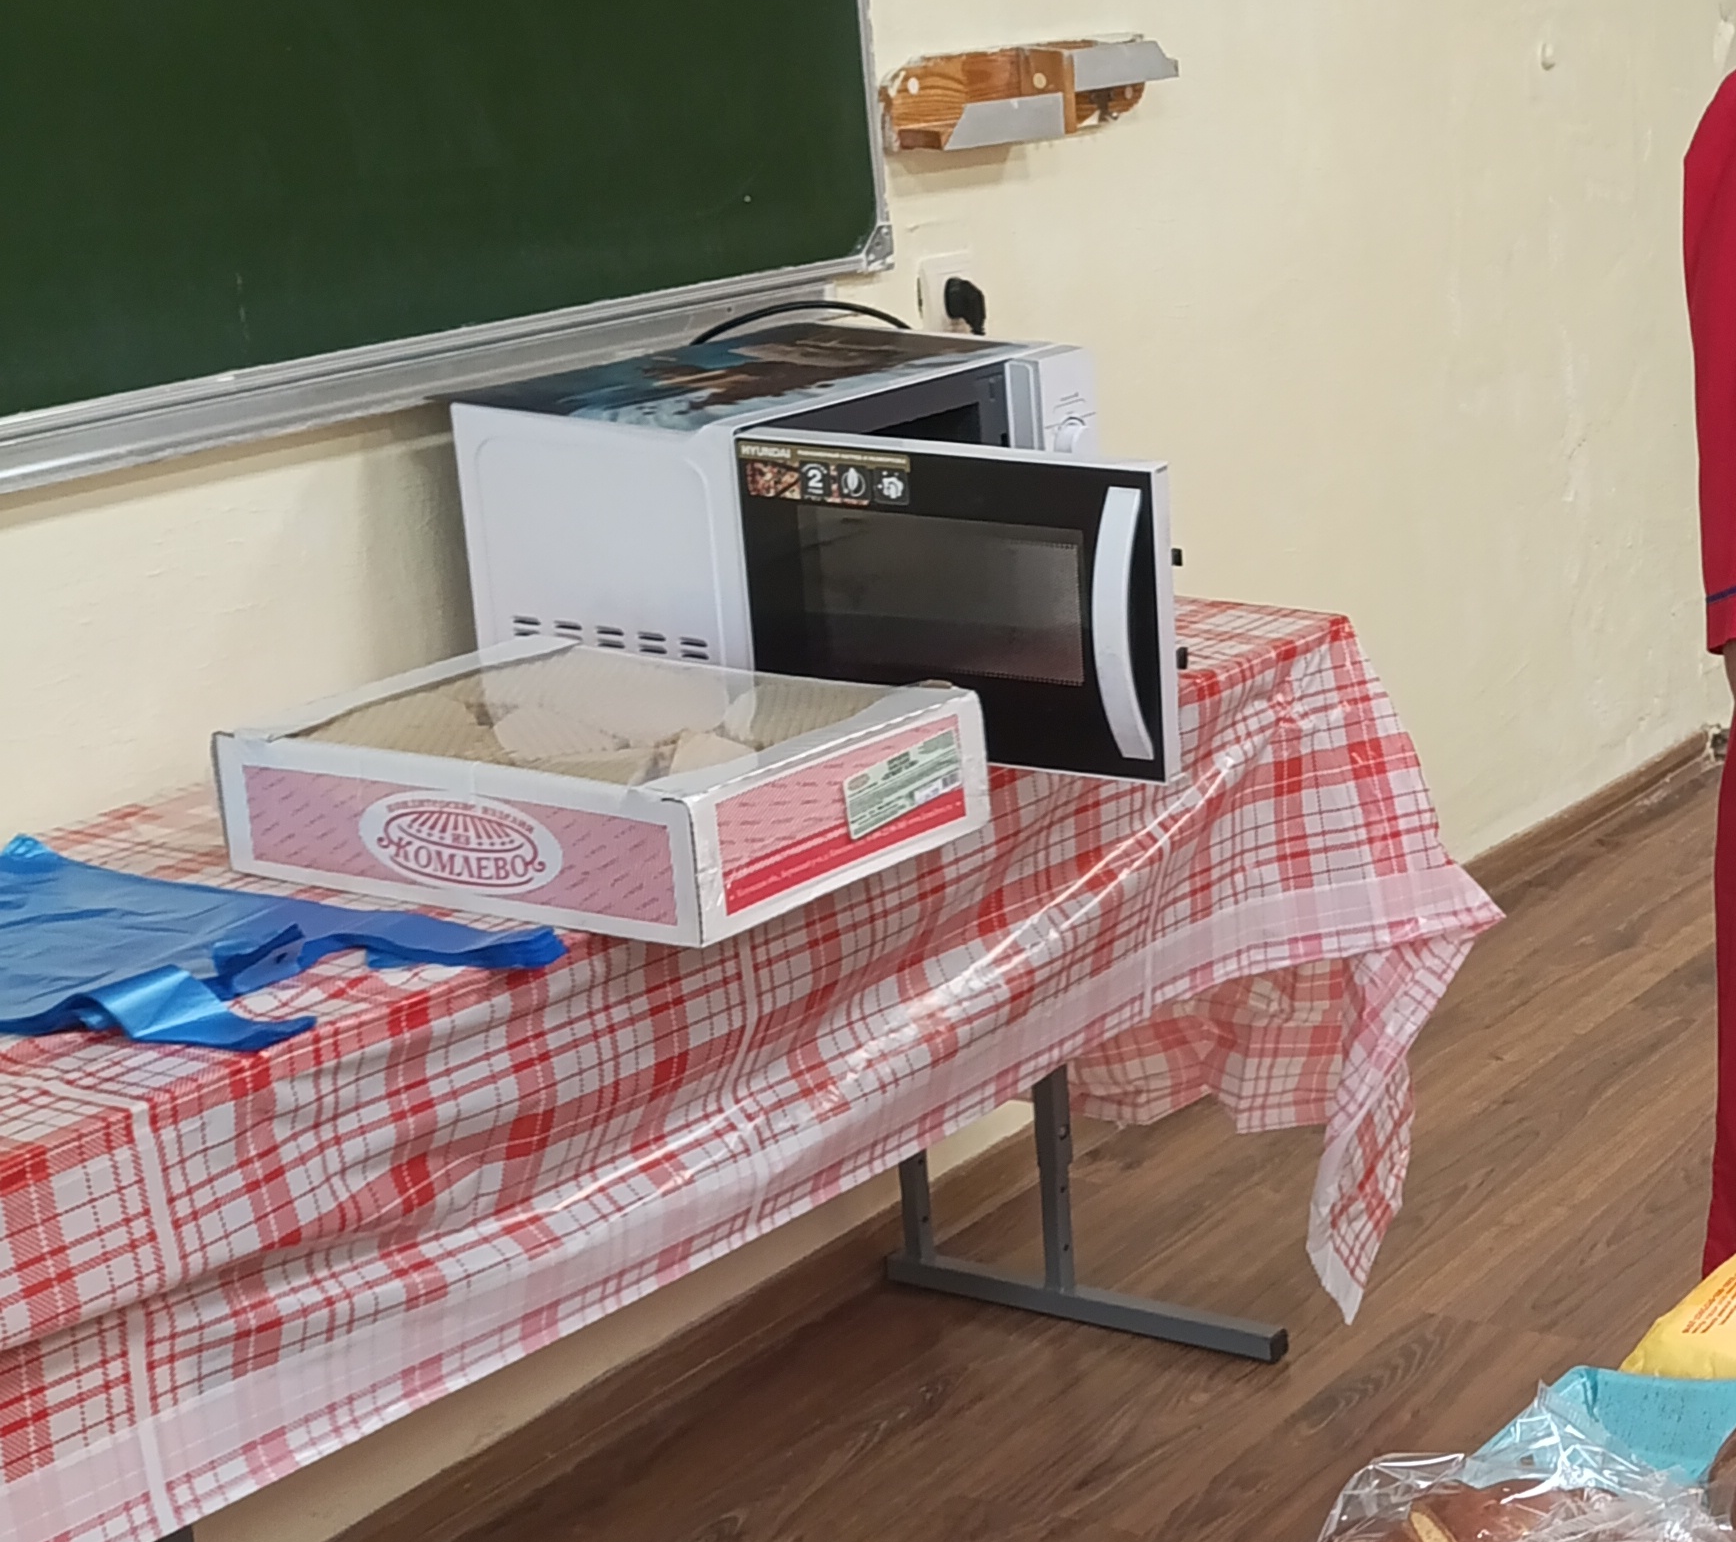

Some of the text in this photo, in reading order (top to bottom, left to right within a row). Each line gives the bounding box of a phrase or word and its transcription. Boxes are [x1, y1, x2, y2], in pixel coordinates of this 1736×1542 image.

[741, 444, 791, 458] HYUNDAI
[807, 469, 823, 488] 2
[391, 836, 530, 881] КОМЛЕВО
